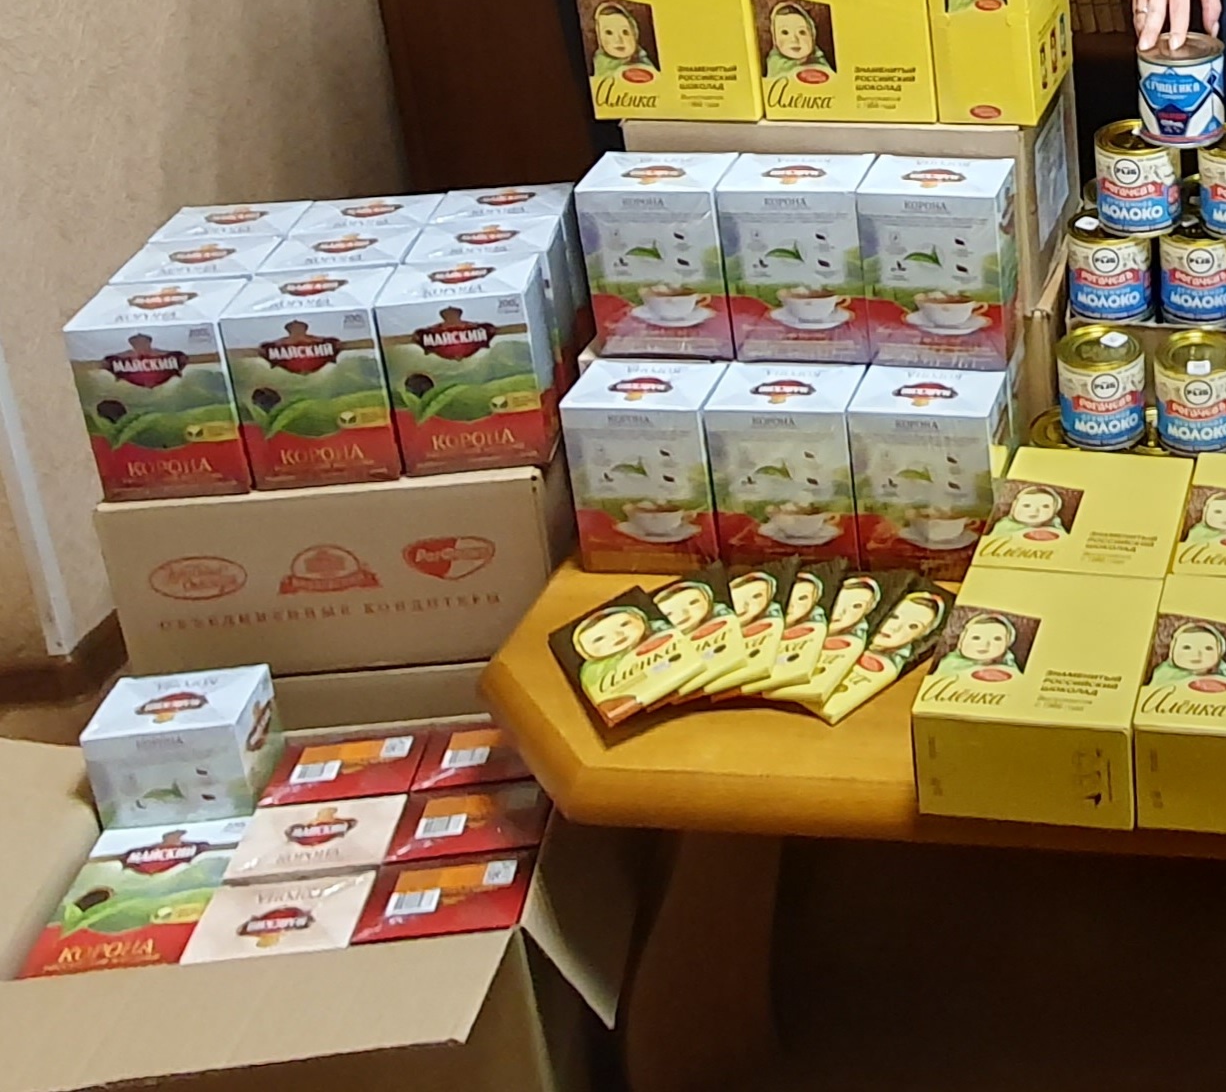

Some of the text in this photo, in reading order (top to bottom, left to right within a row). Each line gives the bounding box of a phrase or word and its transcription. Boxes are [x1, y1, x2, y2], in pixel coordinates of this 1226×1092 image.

[1100, 202, 1162, 220] МОЛОКО
[1076, 290, 1140, 308] МОЛОКО
[422, 328, 488, 346] МАЙСКИЙ
[268, 342, 334, 362] МАЙСКИЙ
[112, 358, 178, 374] МАЙСКИЙ
[1074, 416, 1138, 436] МОЛОКО
[432, 428, 516, 452] КОРОНА
[280, 444, 366, 466] КОРОНА
[128, 458, 212, 478] КОРОНА
[1040, 684, 1098, 696] ШОКОЛАД
[126, 844, 198, 864] МАЙСКИЙ
